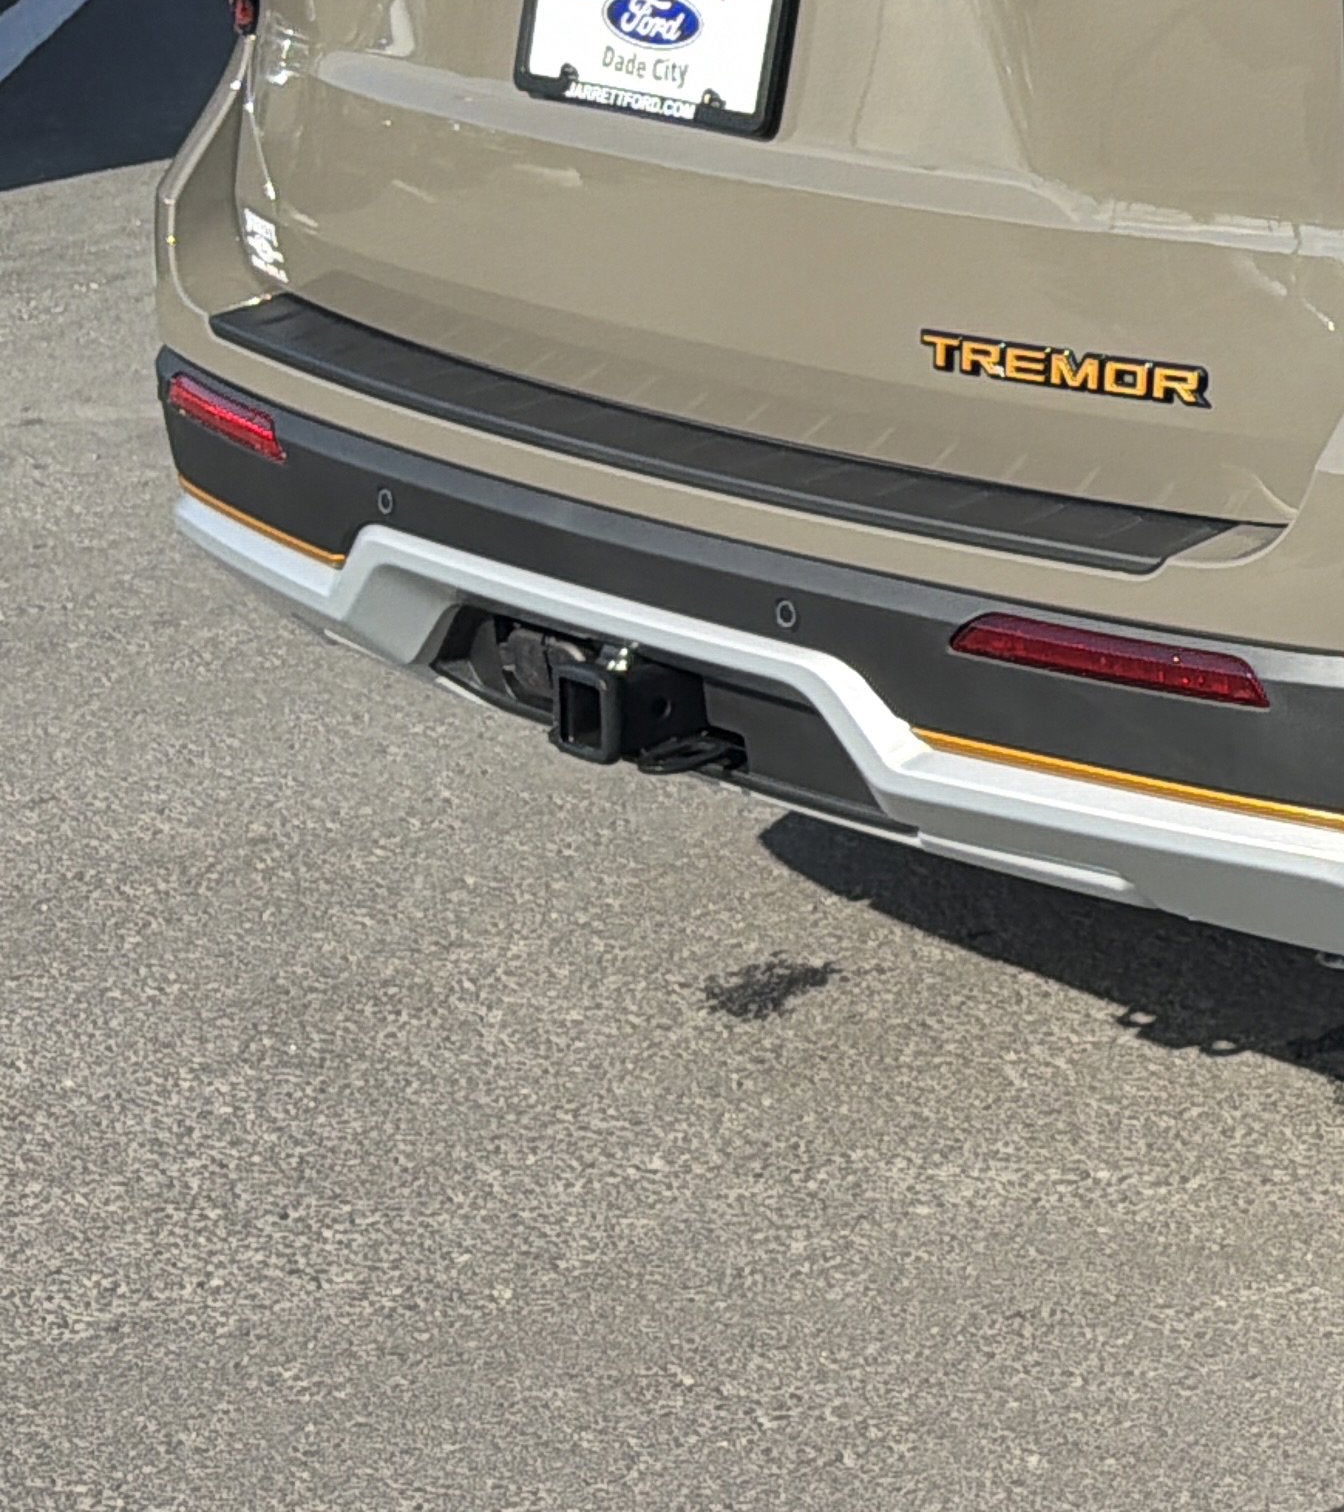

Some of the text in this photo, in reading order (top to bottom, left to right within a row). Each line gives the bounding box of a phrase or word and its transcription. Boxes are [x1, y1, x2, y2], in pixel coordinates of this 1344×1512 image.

[602, 45, 690, 90] Dade City
[564, 81, 697, 120] JARRETTFORD.COM
[920, 328, 1212, 409] TREMOR
